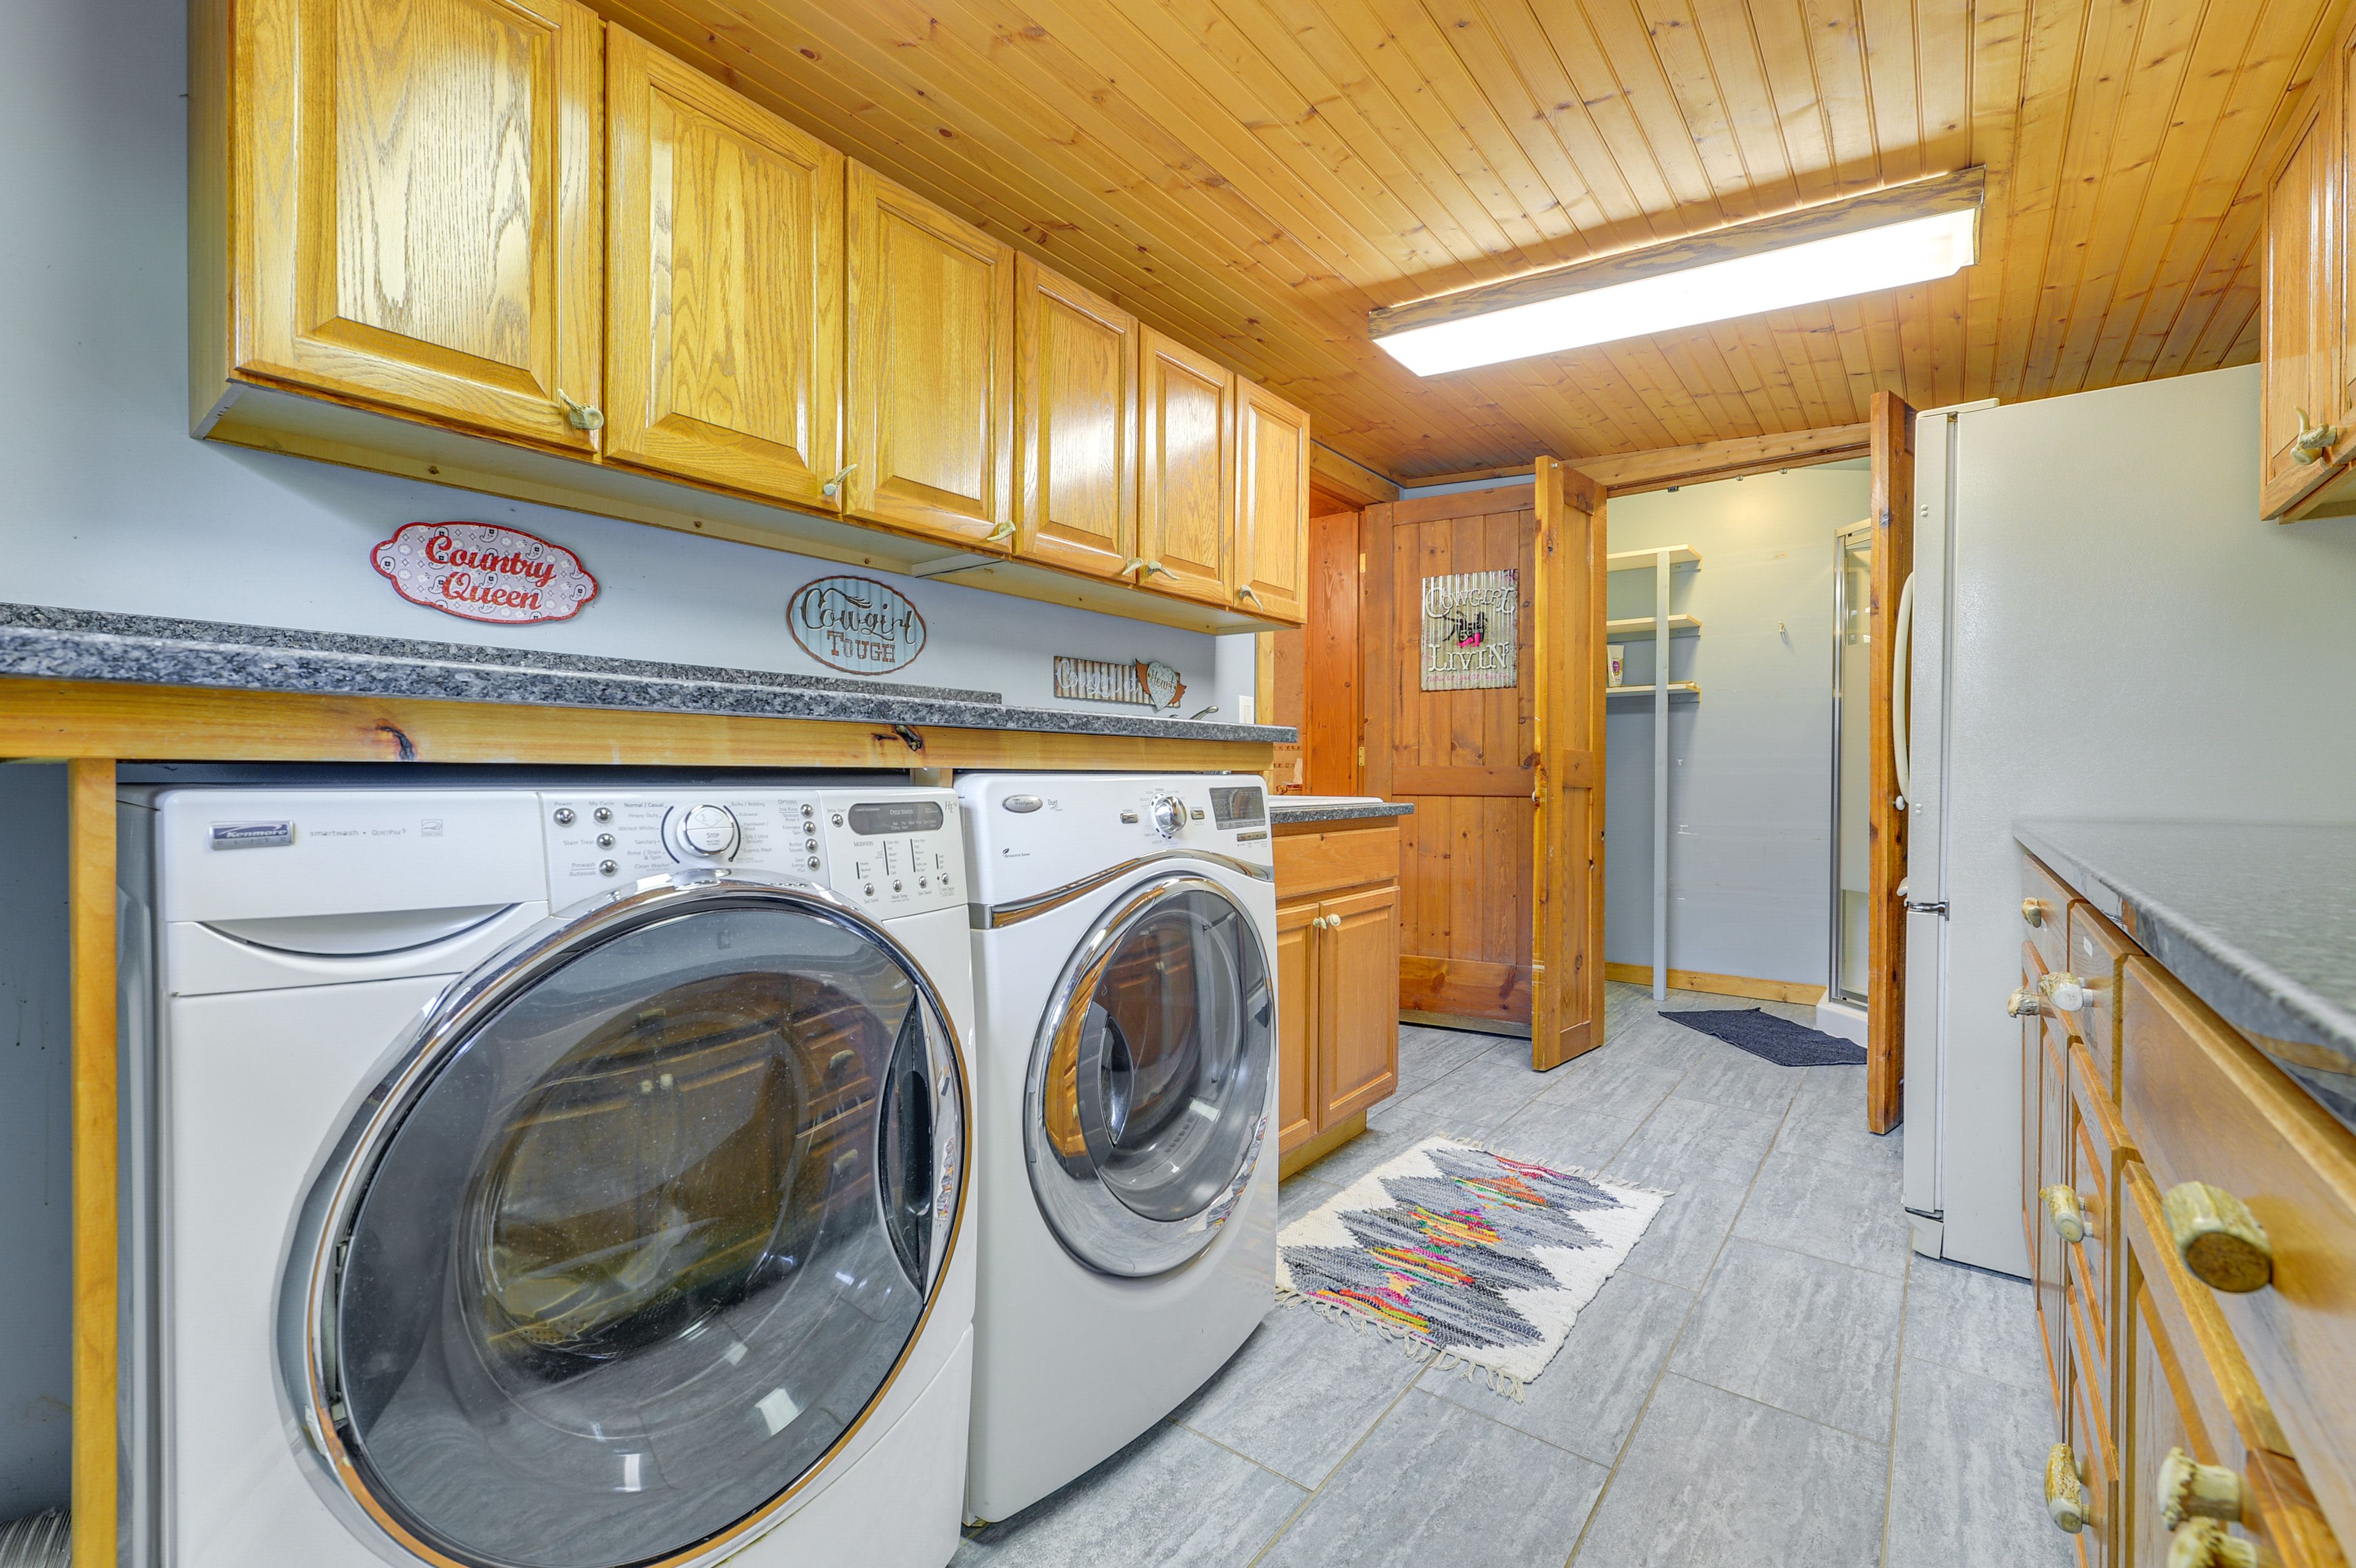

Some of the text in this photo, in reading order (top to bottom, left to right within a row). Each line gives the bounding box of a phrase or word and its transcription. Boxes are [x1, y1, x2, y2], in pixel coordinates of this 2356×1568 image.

[425, 535, 557, 588] Country
[441, 571, 542, 610] Queen
[799, 588, 917, 645] Cowgirl
[826, 630, 896, 663] TOUGH
[1056, 659, 1175, 698] Cowgirl at Heart
[226, 829, 287, 839] Kenmore
